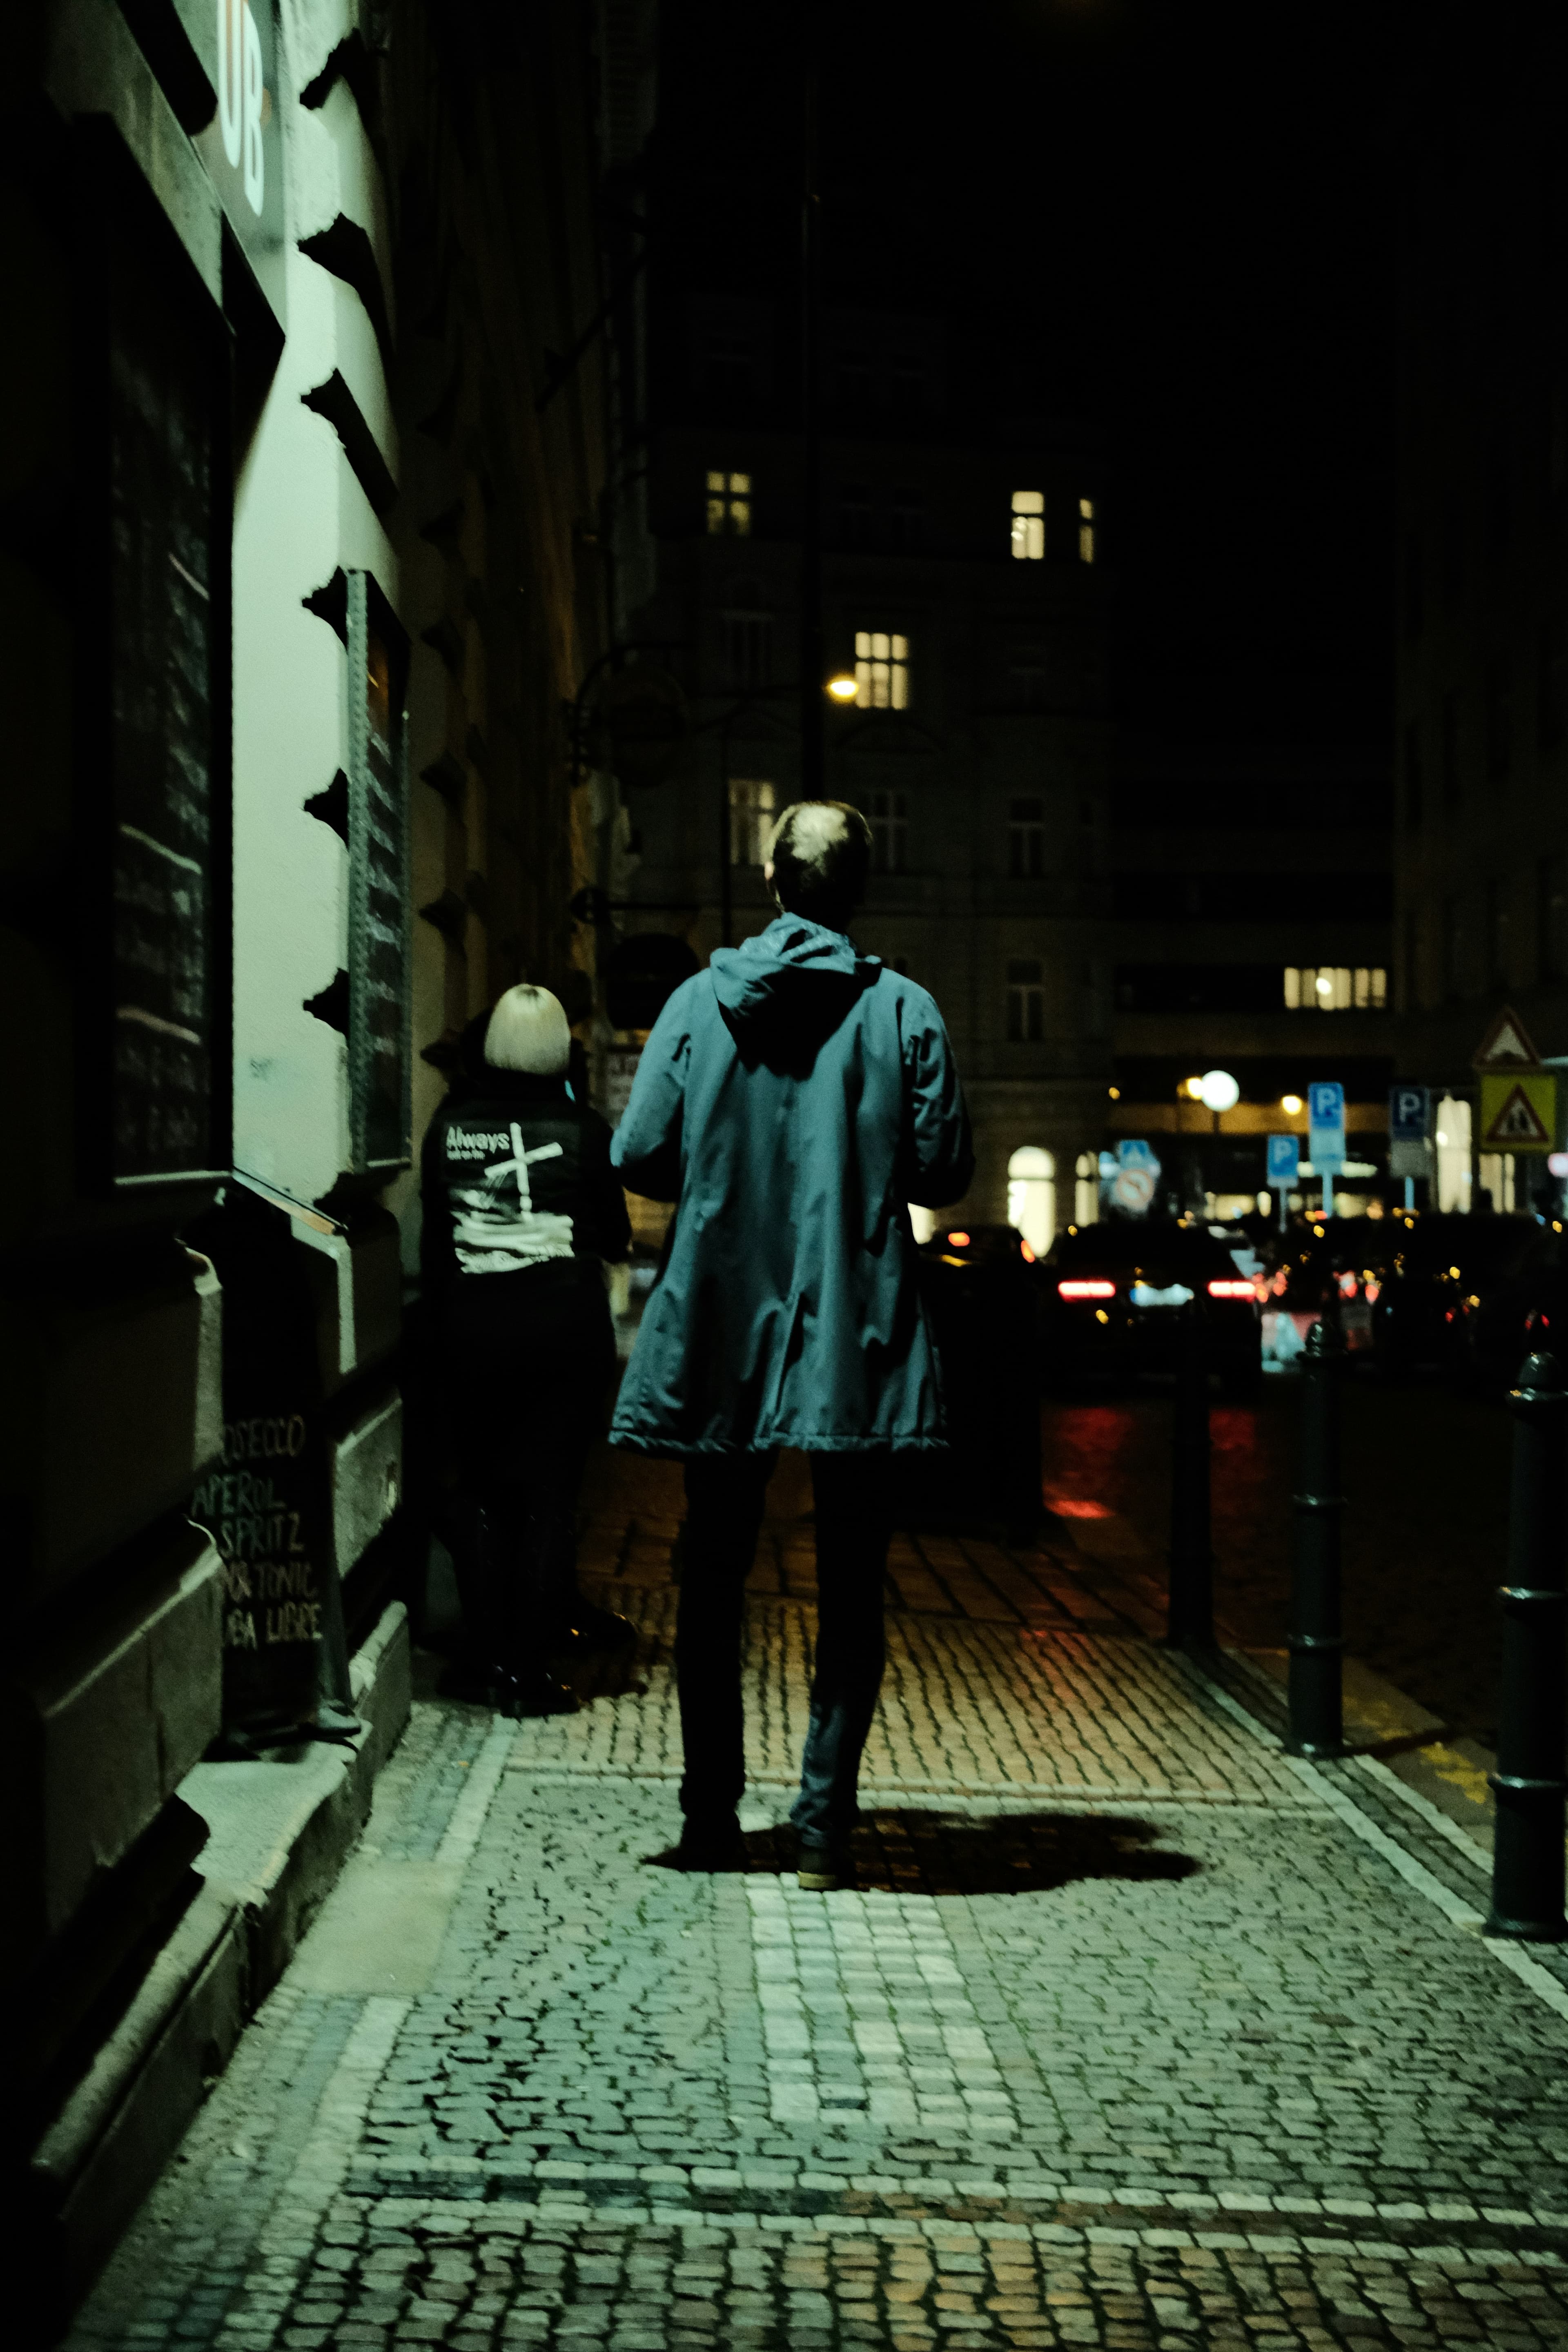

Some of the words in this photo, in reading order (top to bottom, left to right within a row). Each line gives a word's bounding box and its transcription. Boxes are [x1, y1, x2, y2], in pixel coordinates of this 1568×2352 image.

[1316, 1087, 1337, 1116] P
[1398, 1092, 1421, 1123] P
[446, 1126, 510, 1154] Always
[1272, 1140, 1294, 1165] P
[189, 1469, 288, 1522] APEROL
[219, 1510, 306, 1560] SPRITZ
[253, 1559, 319, 1601] TONIC
[265, 1600, 323, 1644] LIBRE
